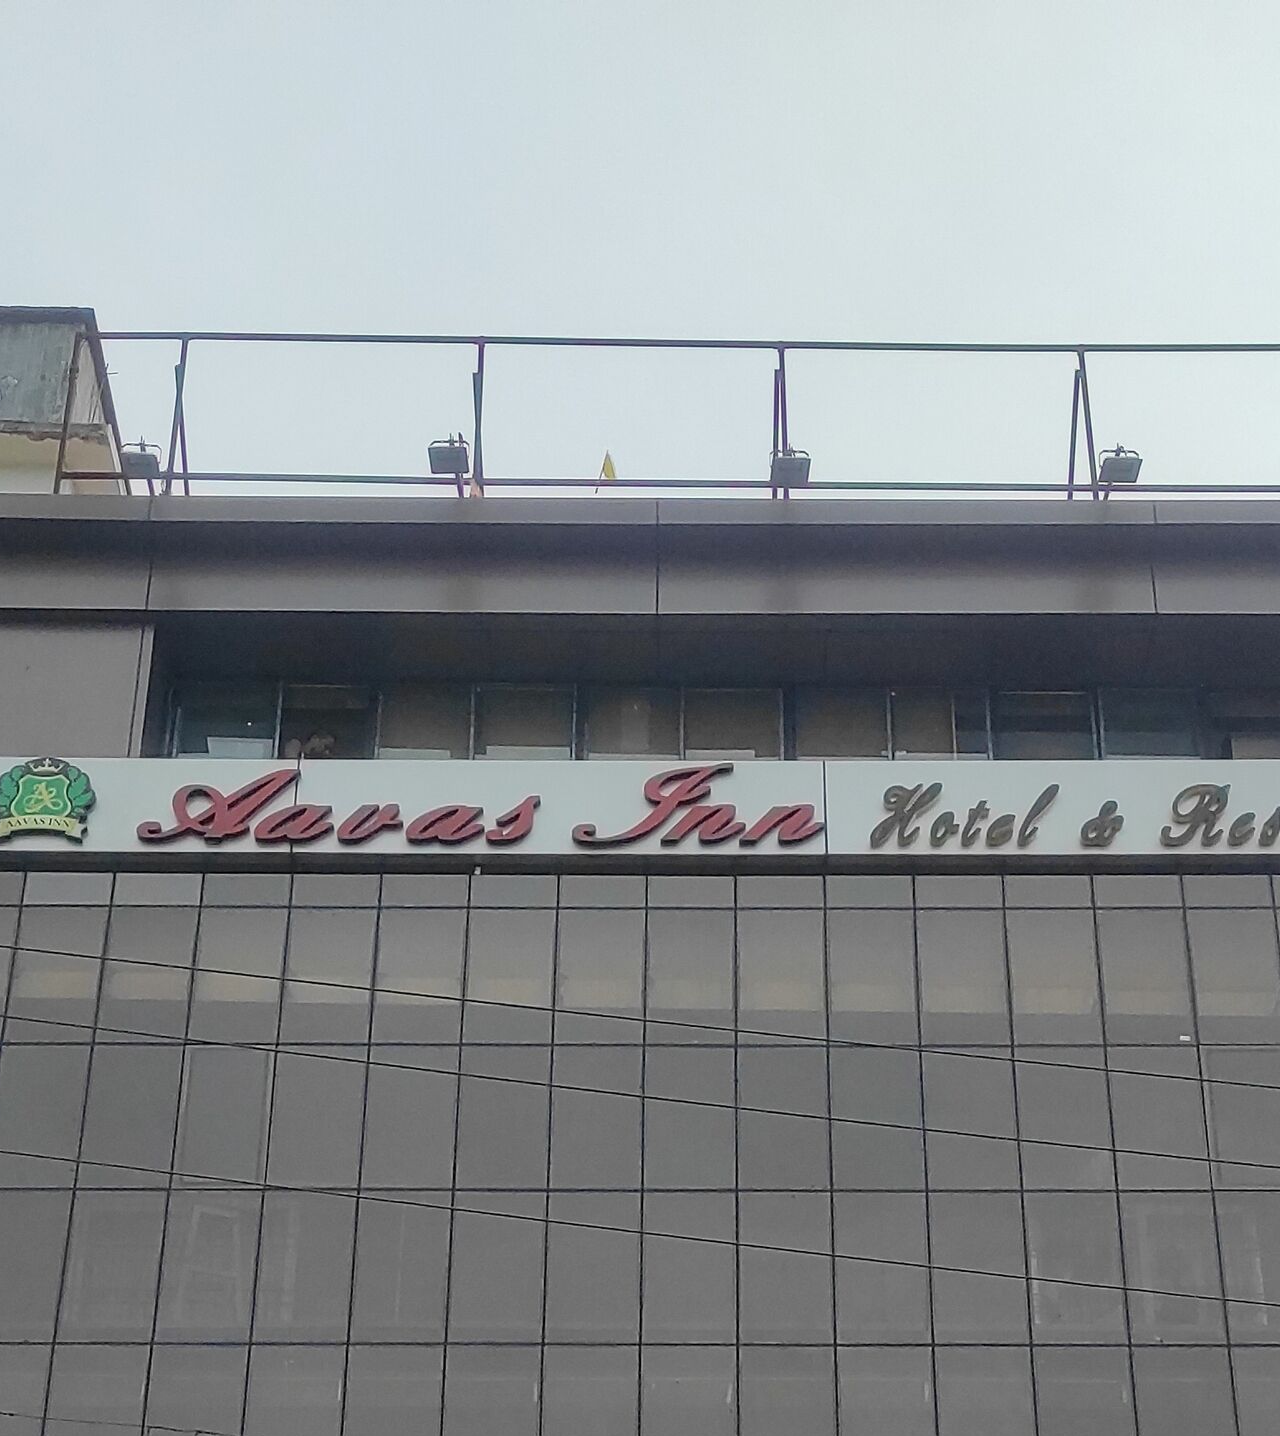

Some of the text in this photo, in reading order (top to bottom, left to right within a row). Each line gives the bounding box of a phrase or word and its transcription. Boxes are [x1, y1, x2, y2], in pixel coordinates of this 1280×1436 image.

[136, 769, 541, 845] Aavas
[572, 762, 825, 850] Inn
[870, 783, 1059, 849] Hotel
[1080, 800, 1124, 847] &
